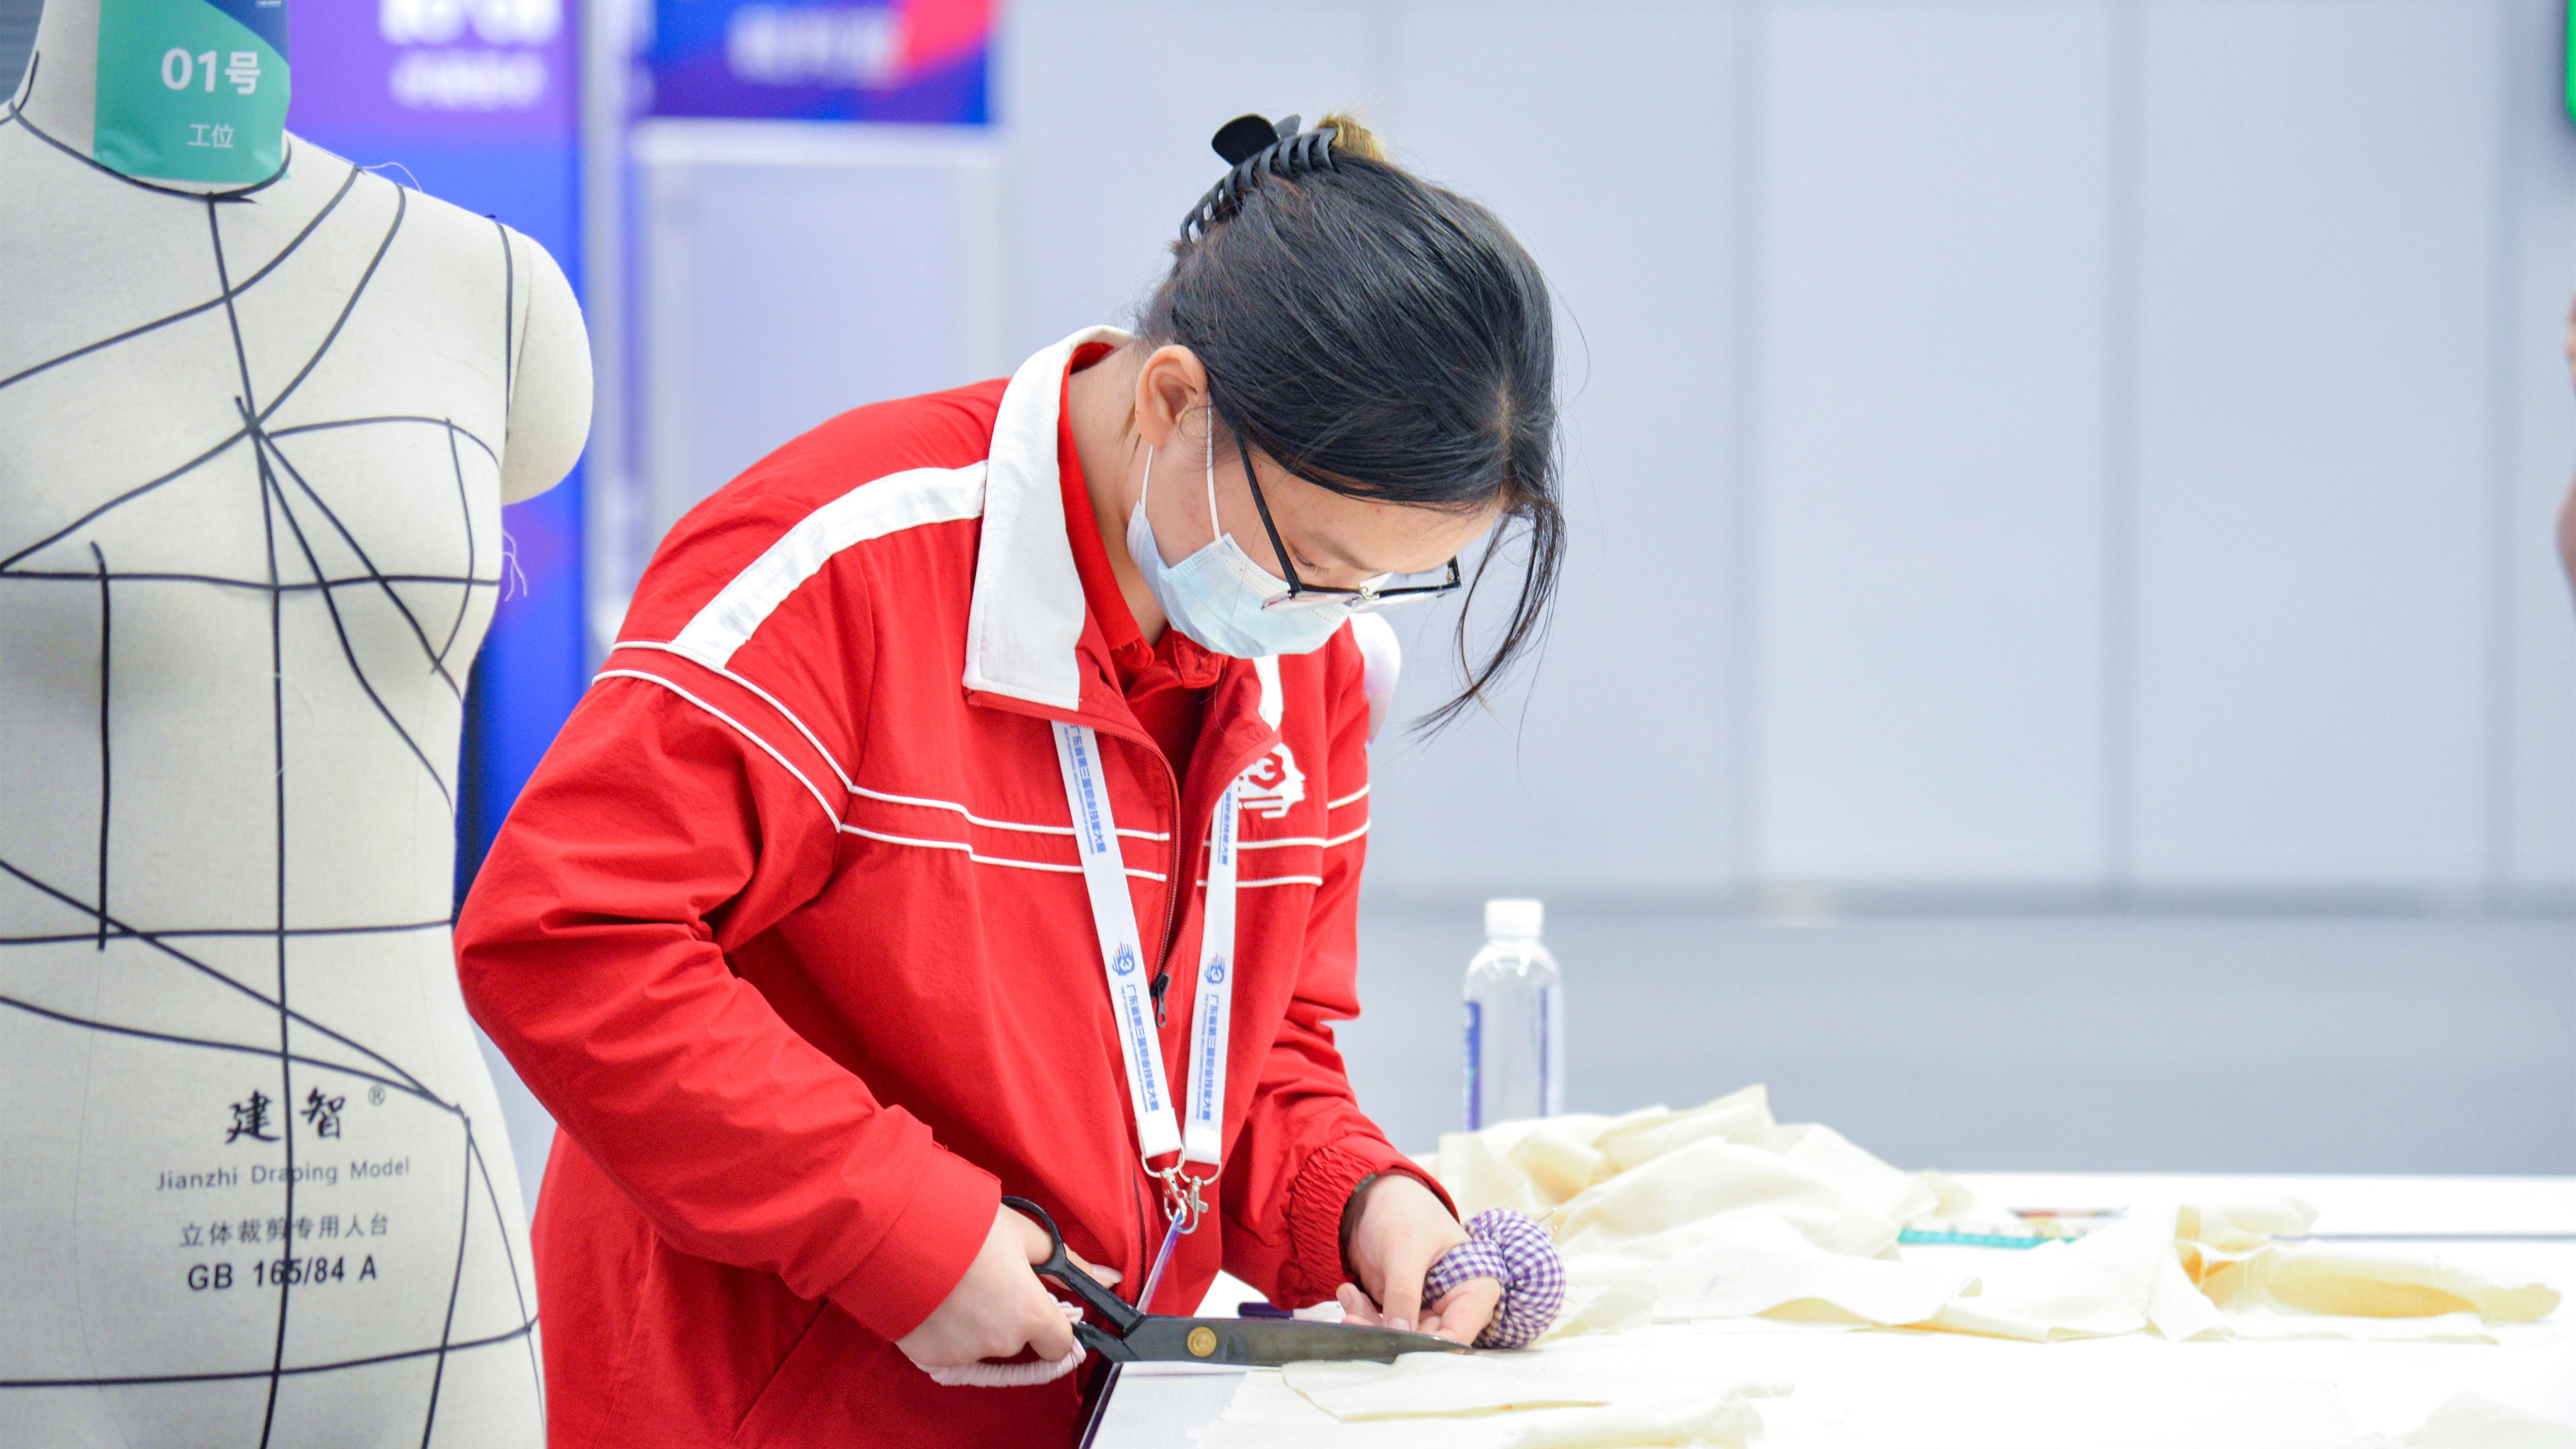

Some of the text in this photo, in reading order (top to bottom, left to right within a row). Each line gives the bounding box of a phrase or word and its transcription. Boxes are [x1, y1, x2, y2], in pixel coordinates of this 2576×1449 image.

[161, 48, 260, 95] 01号
[187, 123, 235, 148] 工位
[225, 1087, 345, 1144] 建智
[157, 1156, 409, 1192] Jianzhi Draping Model
[179, 1212, 388, 1248] 立体裁剪专用人台
[188, 1254, 377, 1291] GB 165/84 A
